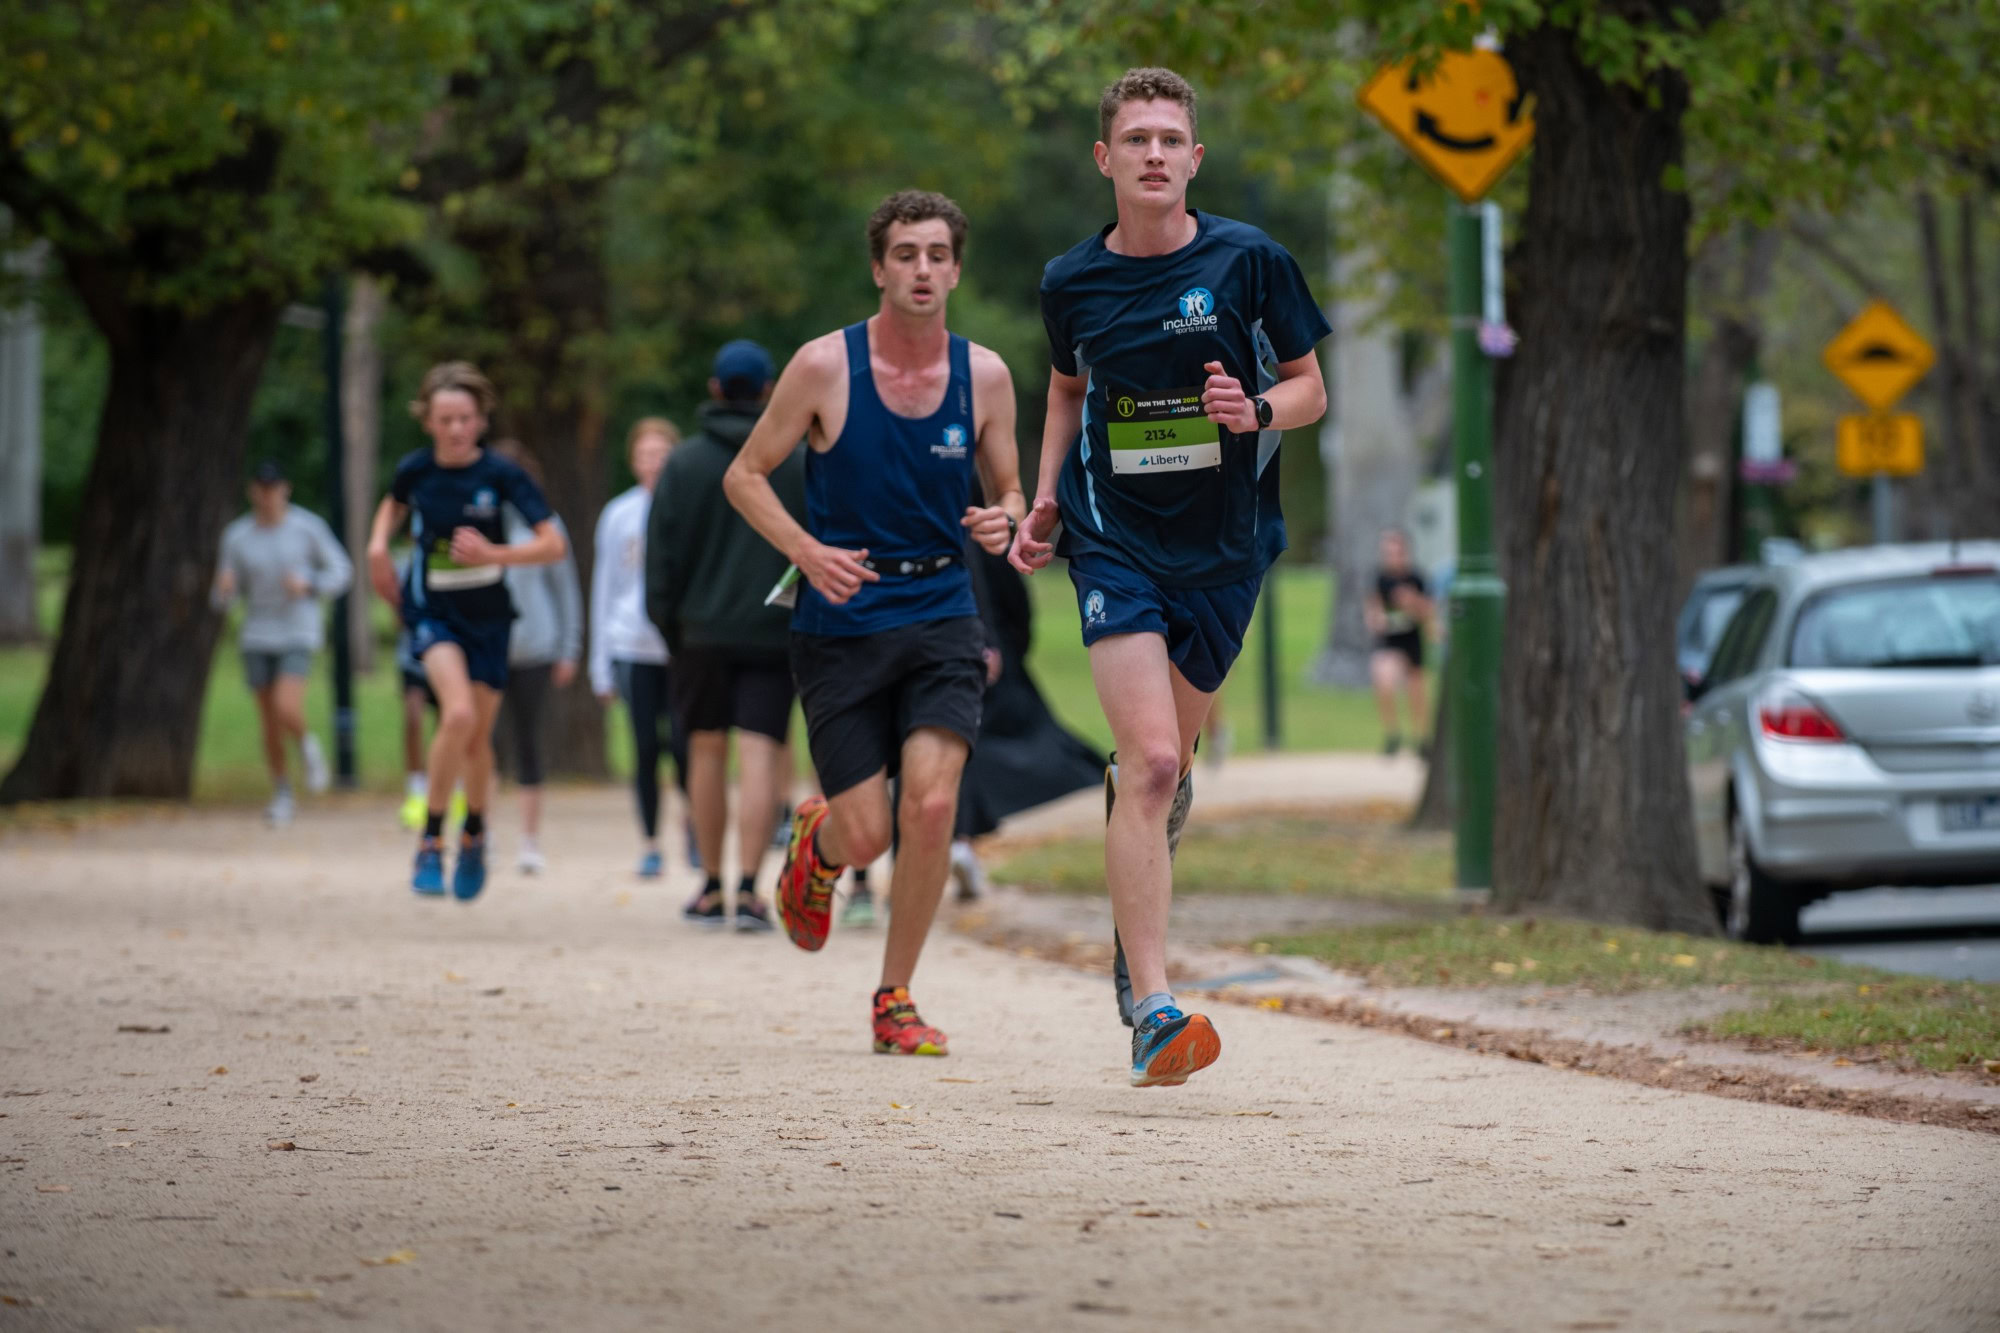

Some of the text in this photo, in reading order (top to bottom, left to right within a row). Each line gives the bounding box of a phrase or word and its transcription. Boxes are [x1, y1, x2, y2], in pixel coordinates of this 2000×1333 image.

[1175, 327, 1194, 335] sports
[1177, 405, 1200, 413] Liberty
[1144, 428, 1177, 441] 2134
[1150, 454, 1190, 465] Liberty
